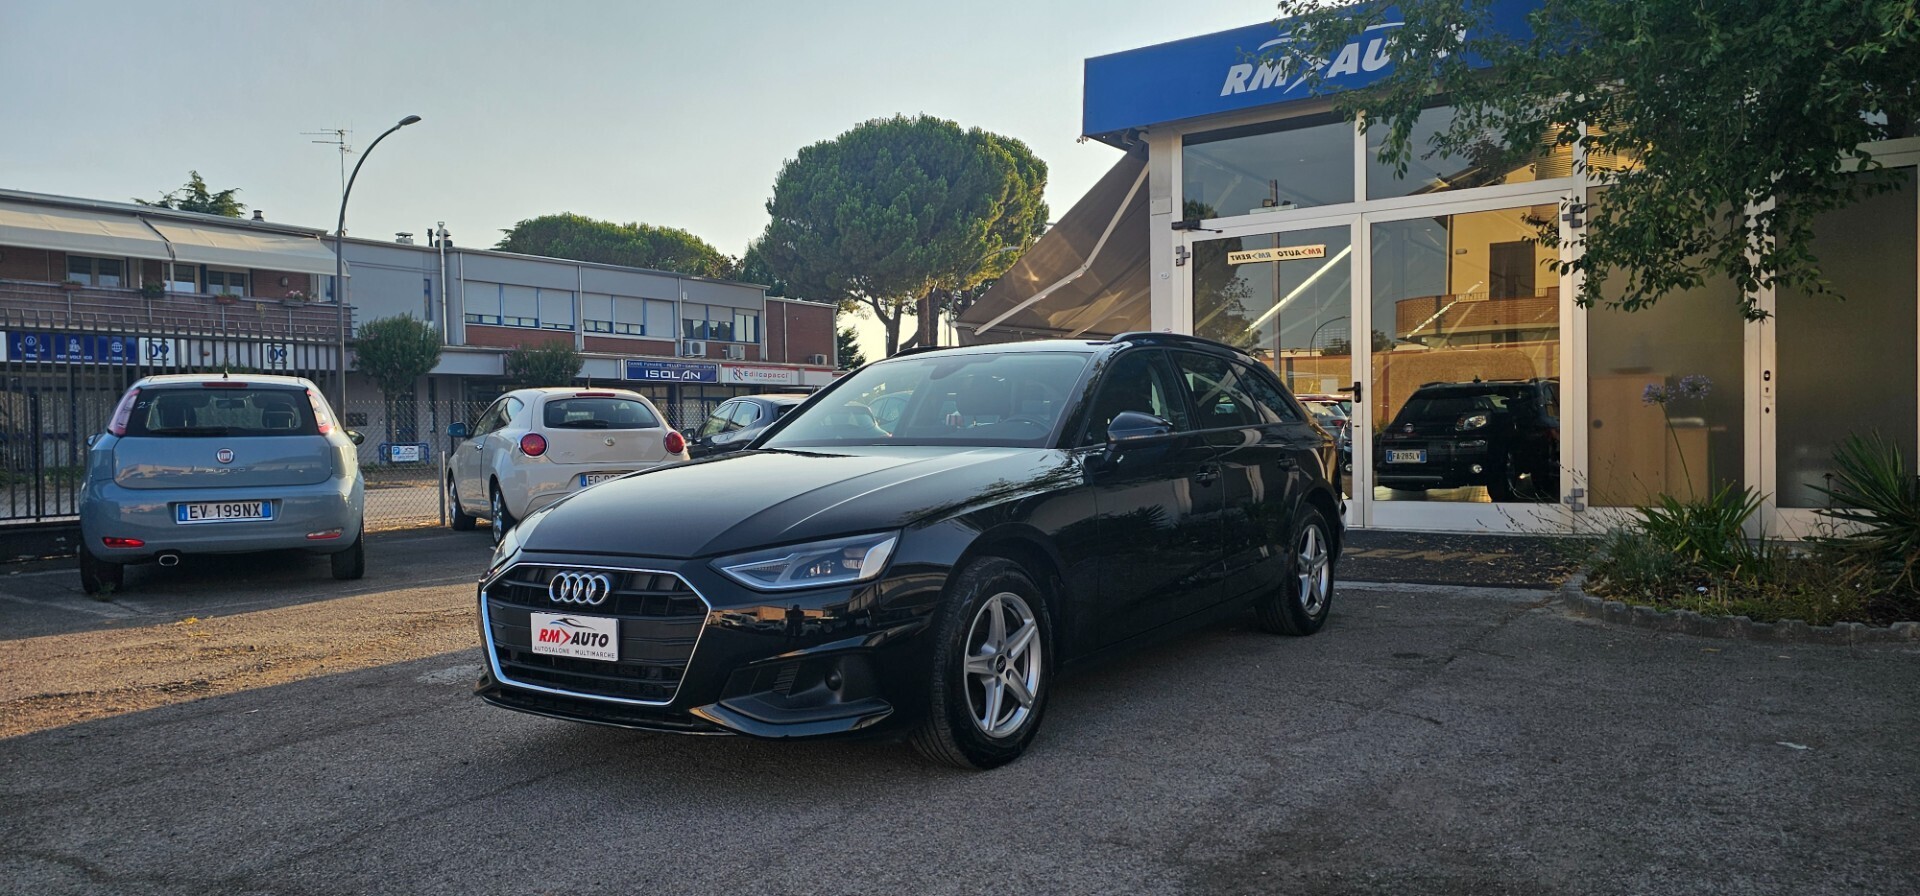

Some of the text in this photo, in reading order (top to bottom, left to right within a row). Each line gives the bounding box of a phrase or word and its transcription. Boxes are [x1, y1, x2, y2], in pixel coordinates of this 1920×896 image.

[645, 370, 701, 381] ISOLAN
[189, 503, 261, 519] EV 199NX
[570, 631, 609, 648] AUTO
[534, 645, 616, 659] AUTOSALONE MULTIMARCHE
